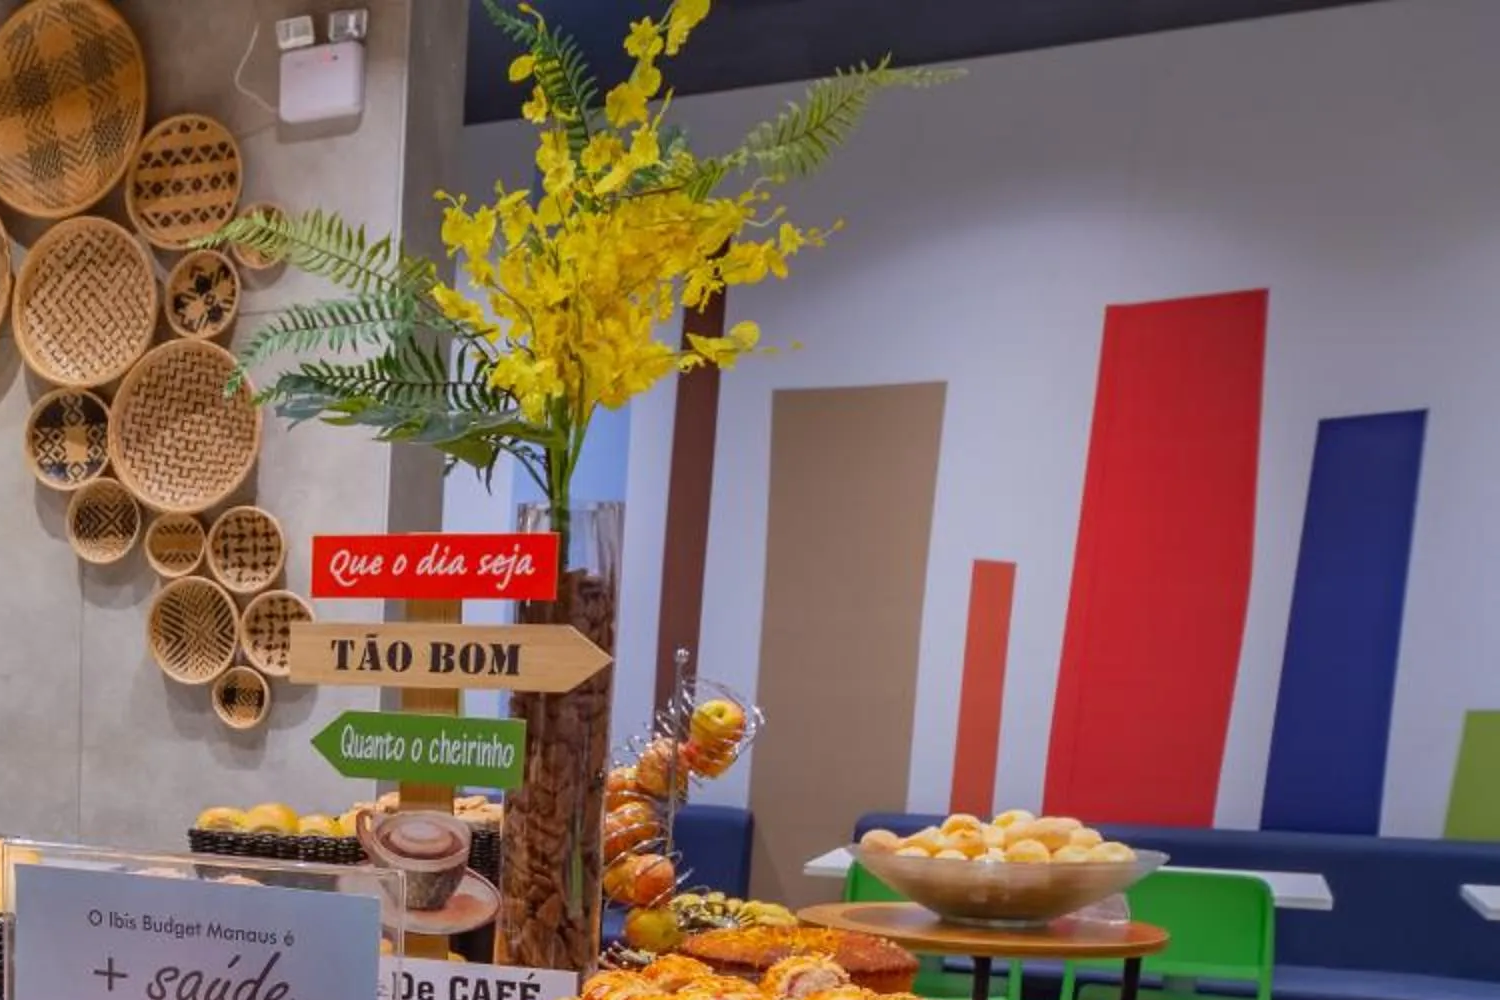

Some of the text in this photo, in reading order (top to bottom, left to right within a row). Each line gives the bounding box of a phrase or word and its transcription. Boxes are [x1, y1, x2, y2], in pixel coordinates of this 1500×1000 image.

[329, 543, 536, 591] Que o dia seja
[331, 633, 522, 676] TÃO BOM
[340, 723, 515, 769] Quanto o cheirinho
[87, 909, 103, 926] O
[109, 911, 137, 930] Ibis
[142, 914, 202, 939] Budget
[206, 922, 277, 945] Manaus
